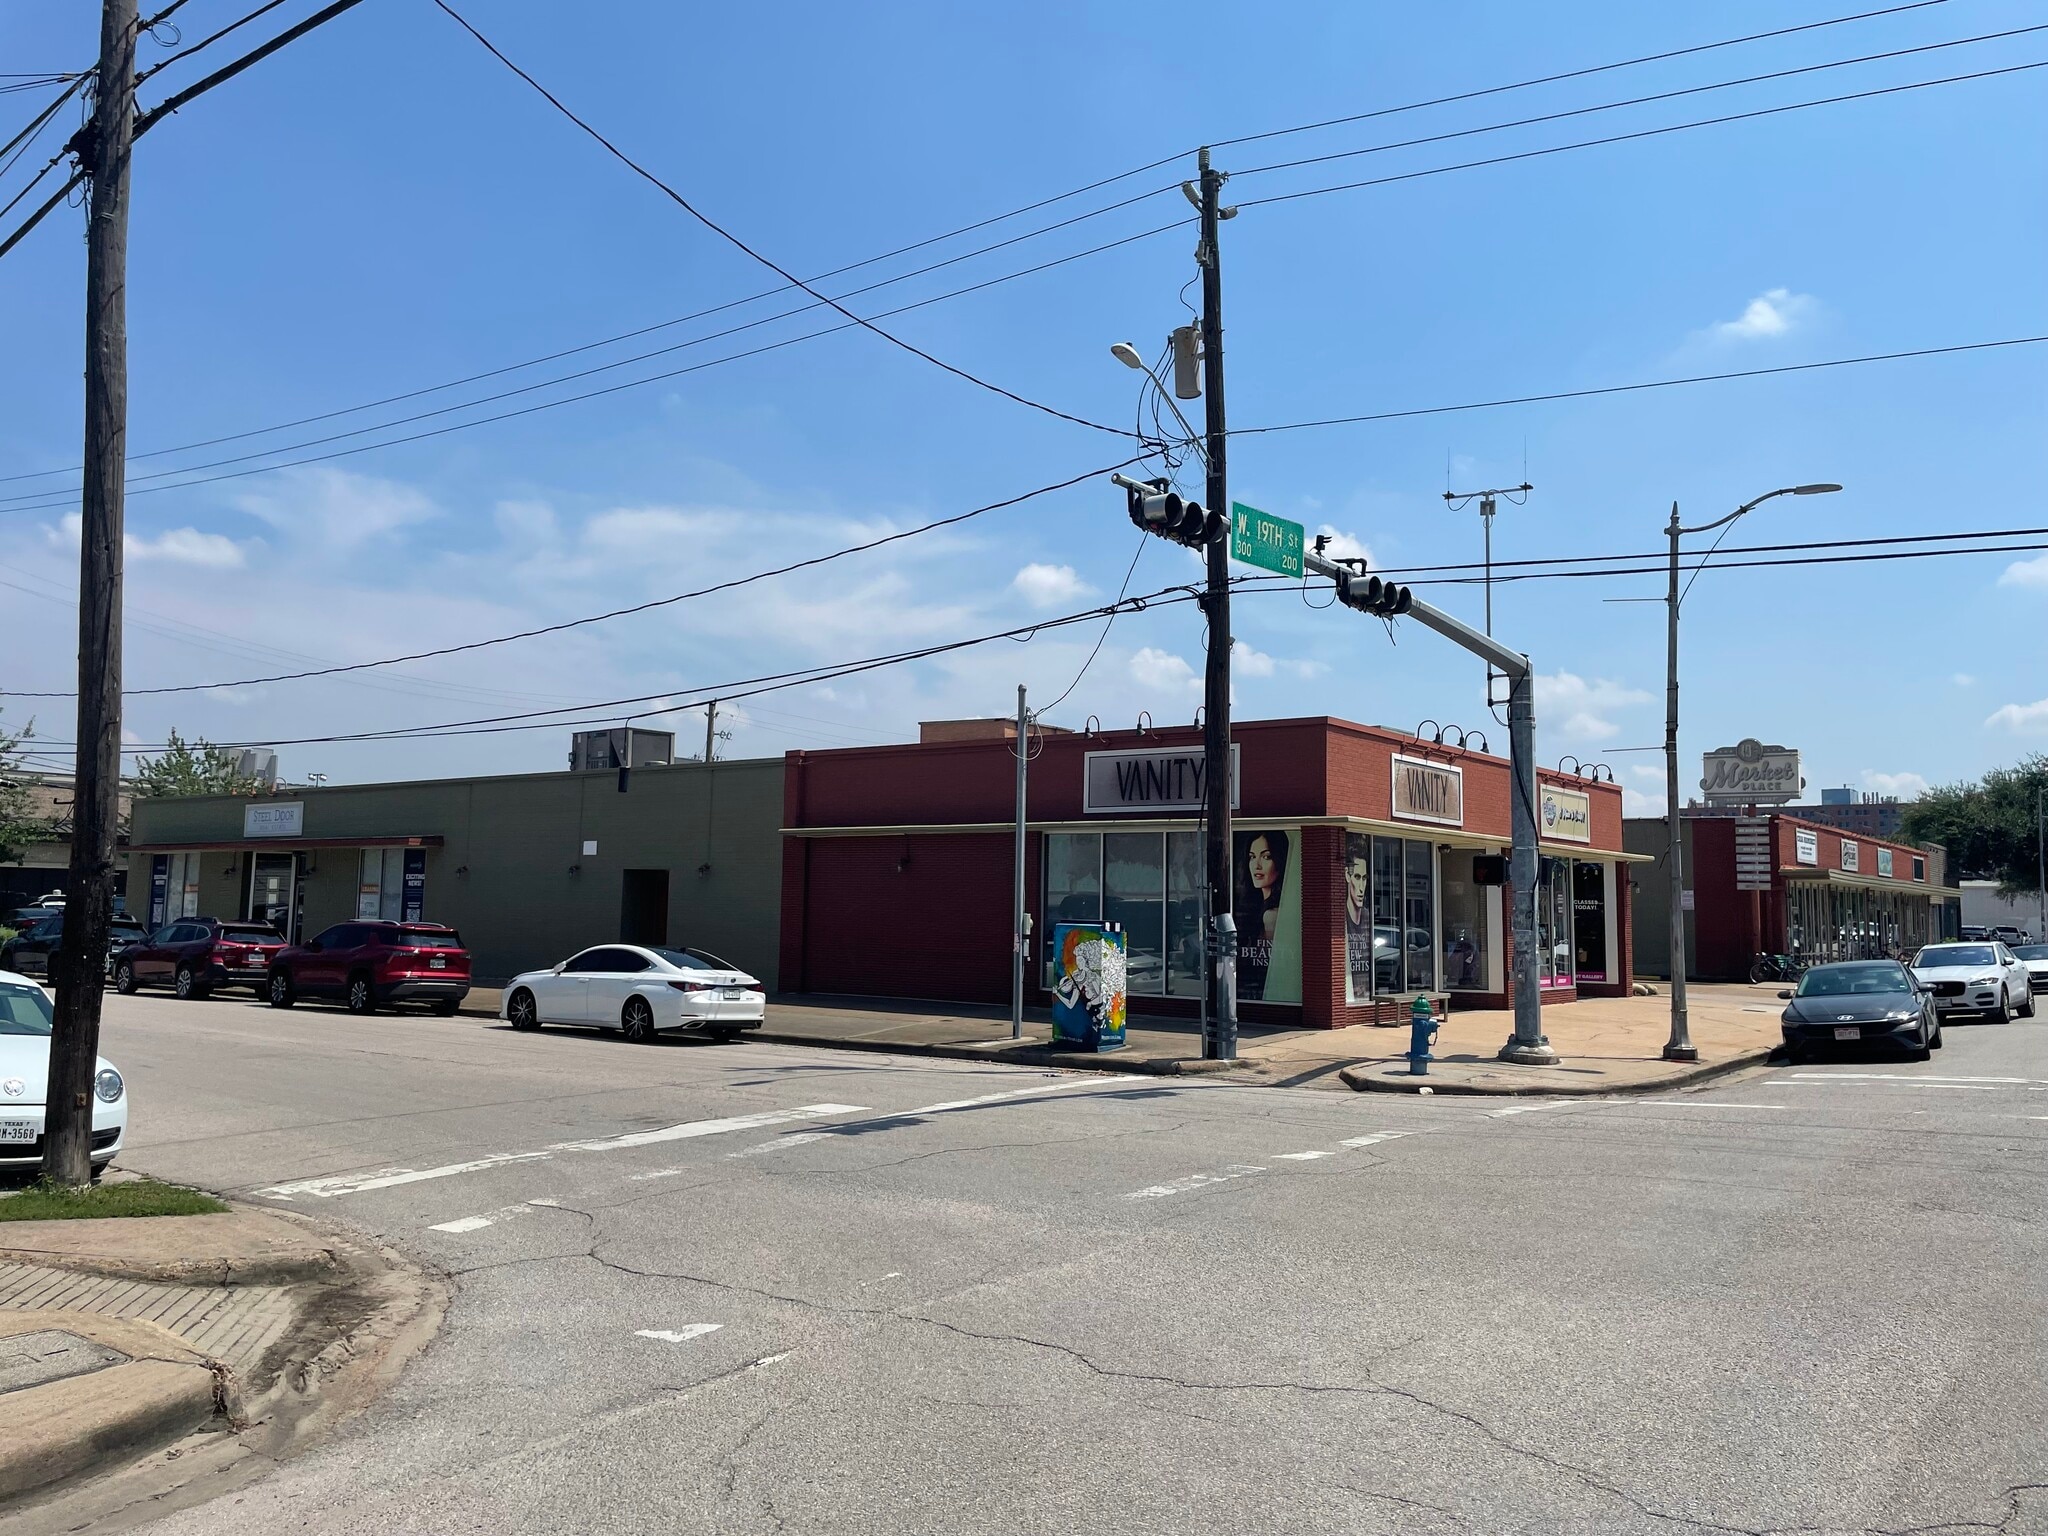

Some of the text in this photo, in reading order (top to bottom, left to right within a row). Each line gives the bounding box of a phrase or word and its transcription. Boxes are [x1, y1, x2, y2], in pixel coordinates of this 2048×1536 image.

[1238, 512, 1250, 536] W.
[1257, 519, 1282, 548] 19TH
[1236, 540, 1251, 557] 300
[1282, 554, 1298, 571] 200
[1116, 757, 1206, 802] VANITY
[1406, 767, 1449, 814] VANITY
[1700, 759, 1794, 791] Market
[1742, 782, 1782, 791] PLACE
